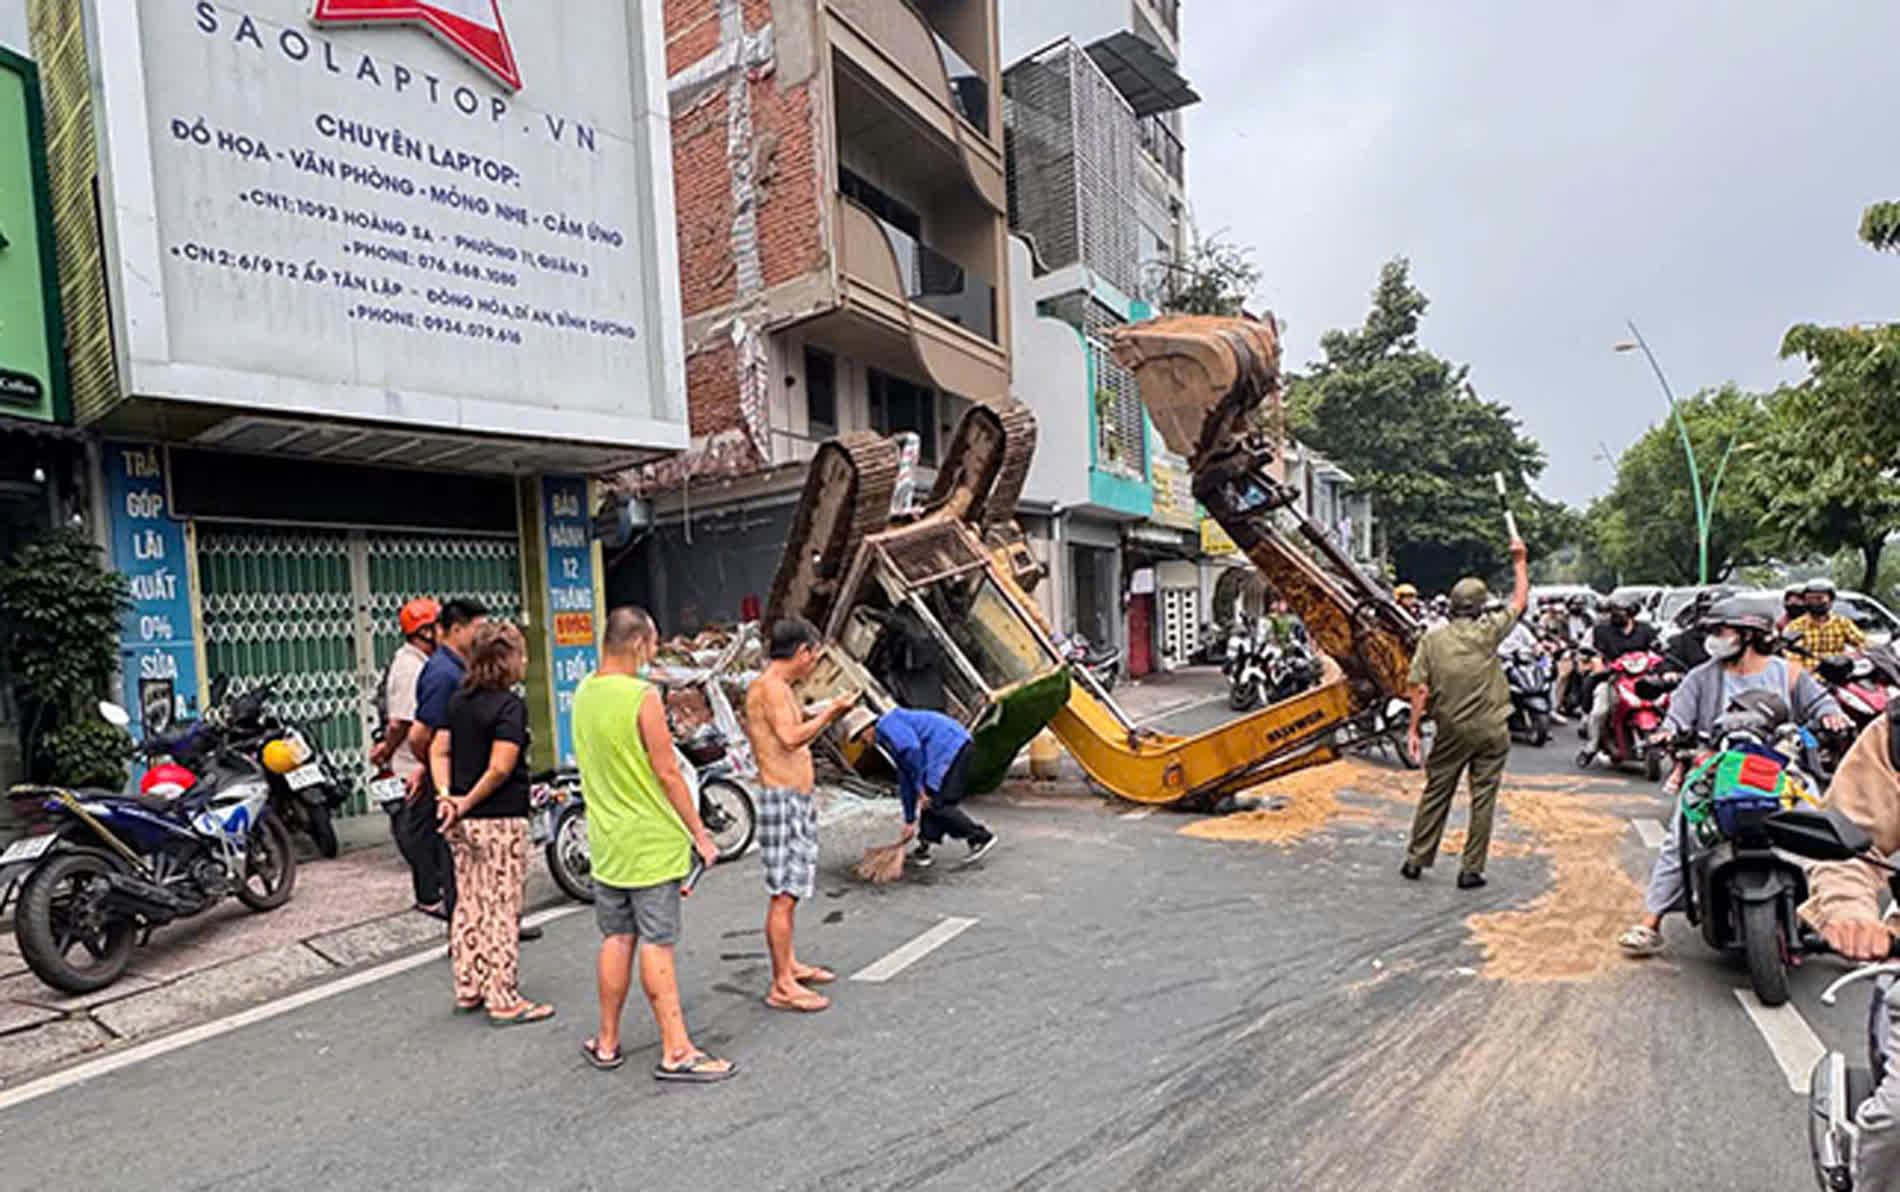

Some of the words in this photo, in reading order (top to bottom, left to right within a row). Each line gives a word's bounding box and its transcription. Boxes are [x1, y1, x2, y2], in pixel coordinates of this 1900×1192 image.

[217, 130, 272, 162] HỌA
[289, 148, 335, 178] VĂN
[340, 164, 415, 197] PHÒNG
[315, 113, 422, 161] CHUYÊN
[429, 144, 521, 188] LAPTOP:
[343, 208, 407, 238] HOÀNG
[412, 225, 434, 243] SA
[126, 489, 163, 518] GÓP
[133, 529, 164, 560] LÃI
[562, 556, 579, 579] 12
[551, 584, 592, 610] THÁNG
[140, 615, 172, 641] 0%
